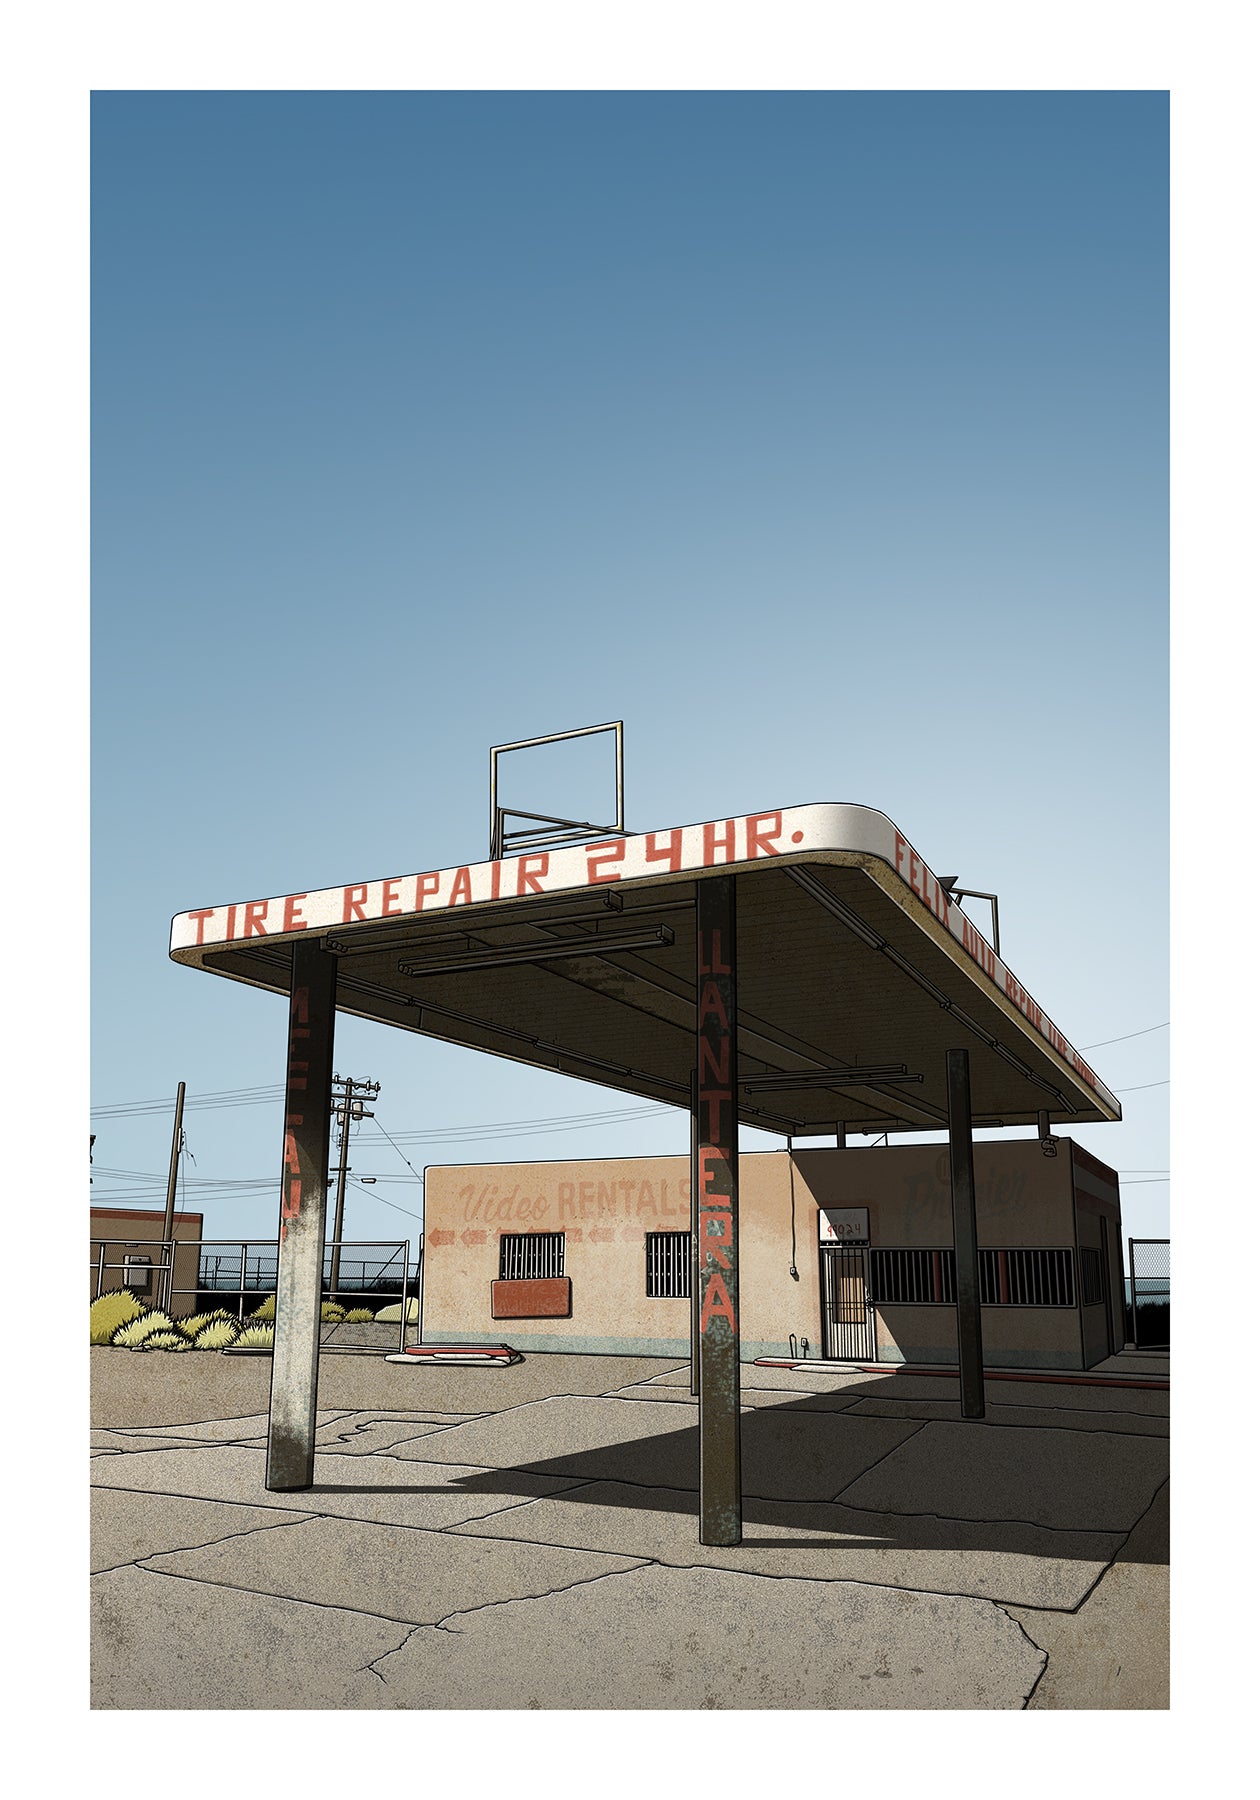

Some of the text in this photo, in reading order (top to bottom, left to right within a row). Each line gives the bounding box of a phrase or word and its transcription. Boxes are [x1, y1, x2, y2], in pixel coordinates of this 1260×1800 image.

[188, 893, 308, 946] TIRE
[342, 853, 550, 924] REPAIR
[895, 830, 950, 930] FELIX
[962, 917, 996, 980] AUTO
[1005, 970, 1044, 1033] REPAIR
[459, 1182, 550, 1223] Video
[699, 929, 739, 1335] LLANTERA
